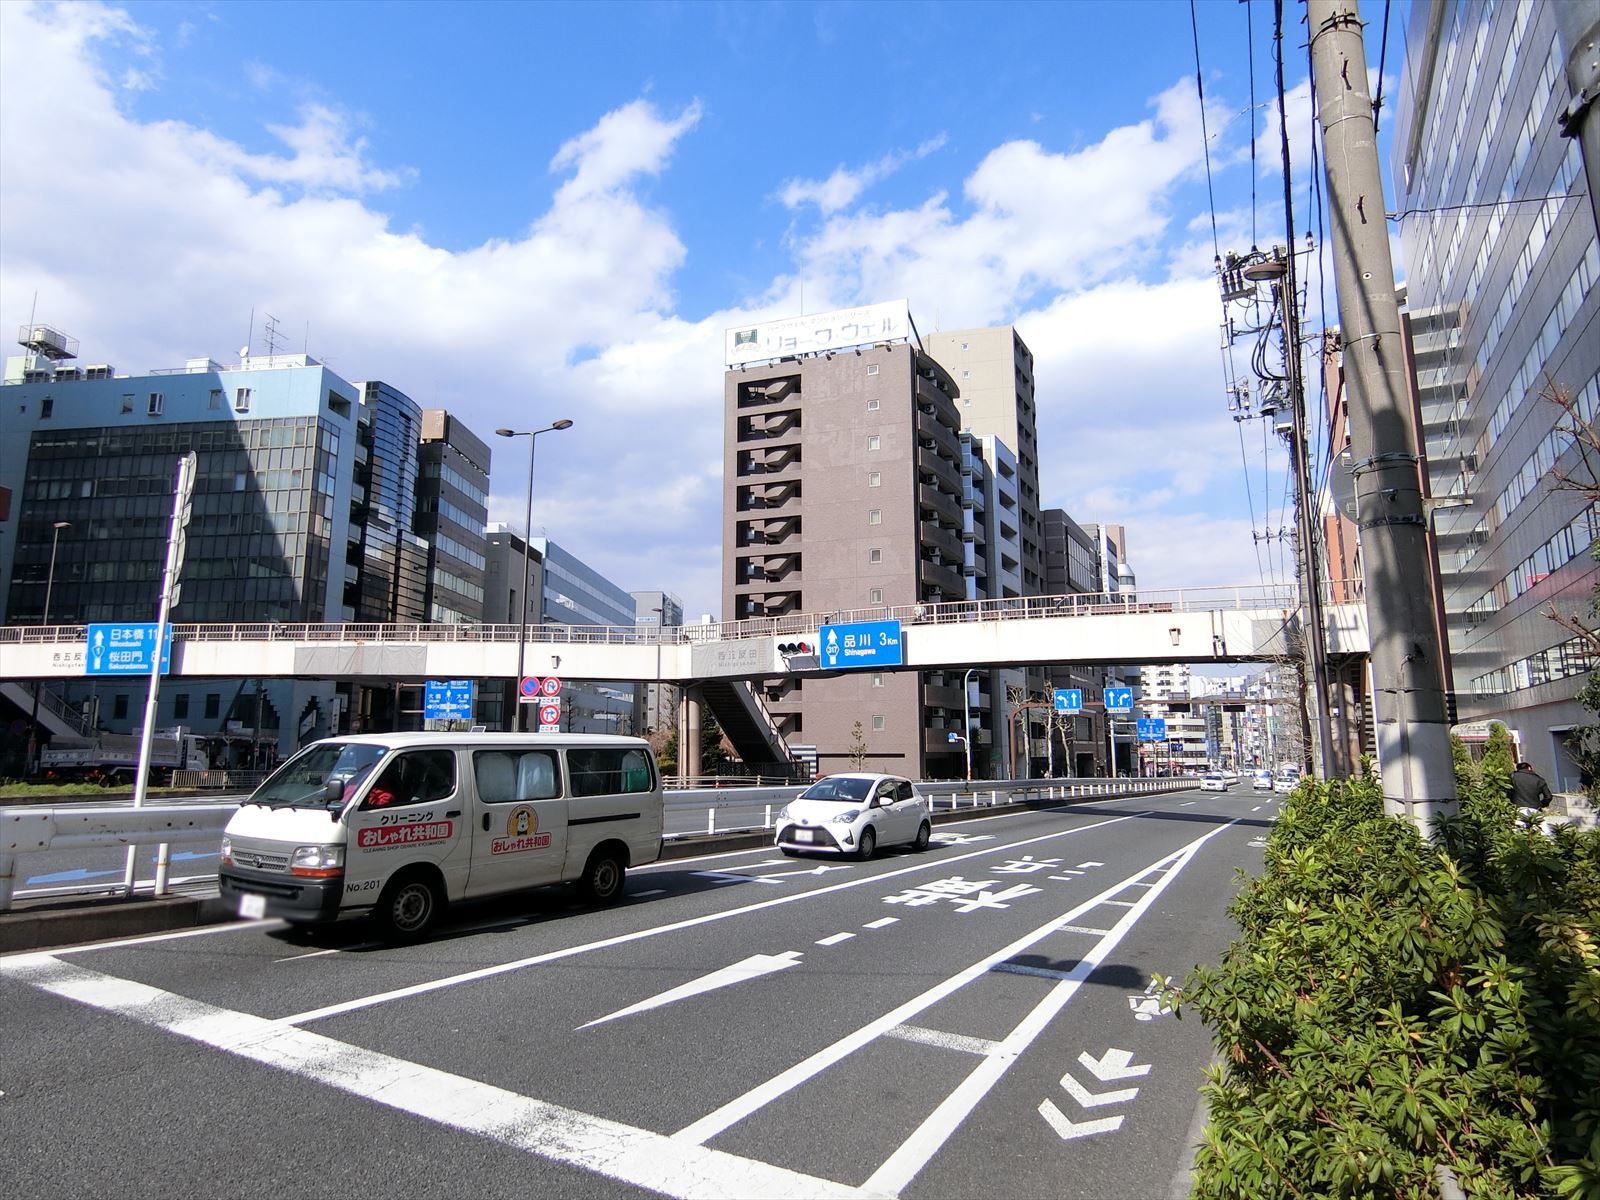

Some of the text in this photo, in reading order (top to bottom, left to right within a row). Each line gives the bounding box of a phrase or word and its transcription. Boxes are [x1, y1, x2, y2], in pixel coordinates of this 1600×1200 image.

[111, 628, 144, 640] 日本橋
[844, 633, 871, 648] 品川
[109, 650, 142, 662] 桜田門
[844, 648, 876, 656] Shinagawa
[380, 811, 434, 825] クリーニング
[363, 823, 449, 847] おしゃれ共和国
[493, 835, 550, 853] おしゃれ共和国
[345, 880, 380, 893] No.201
